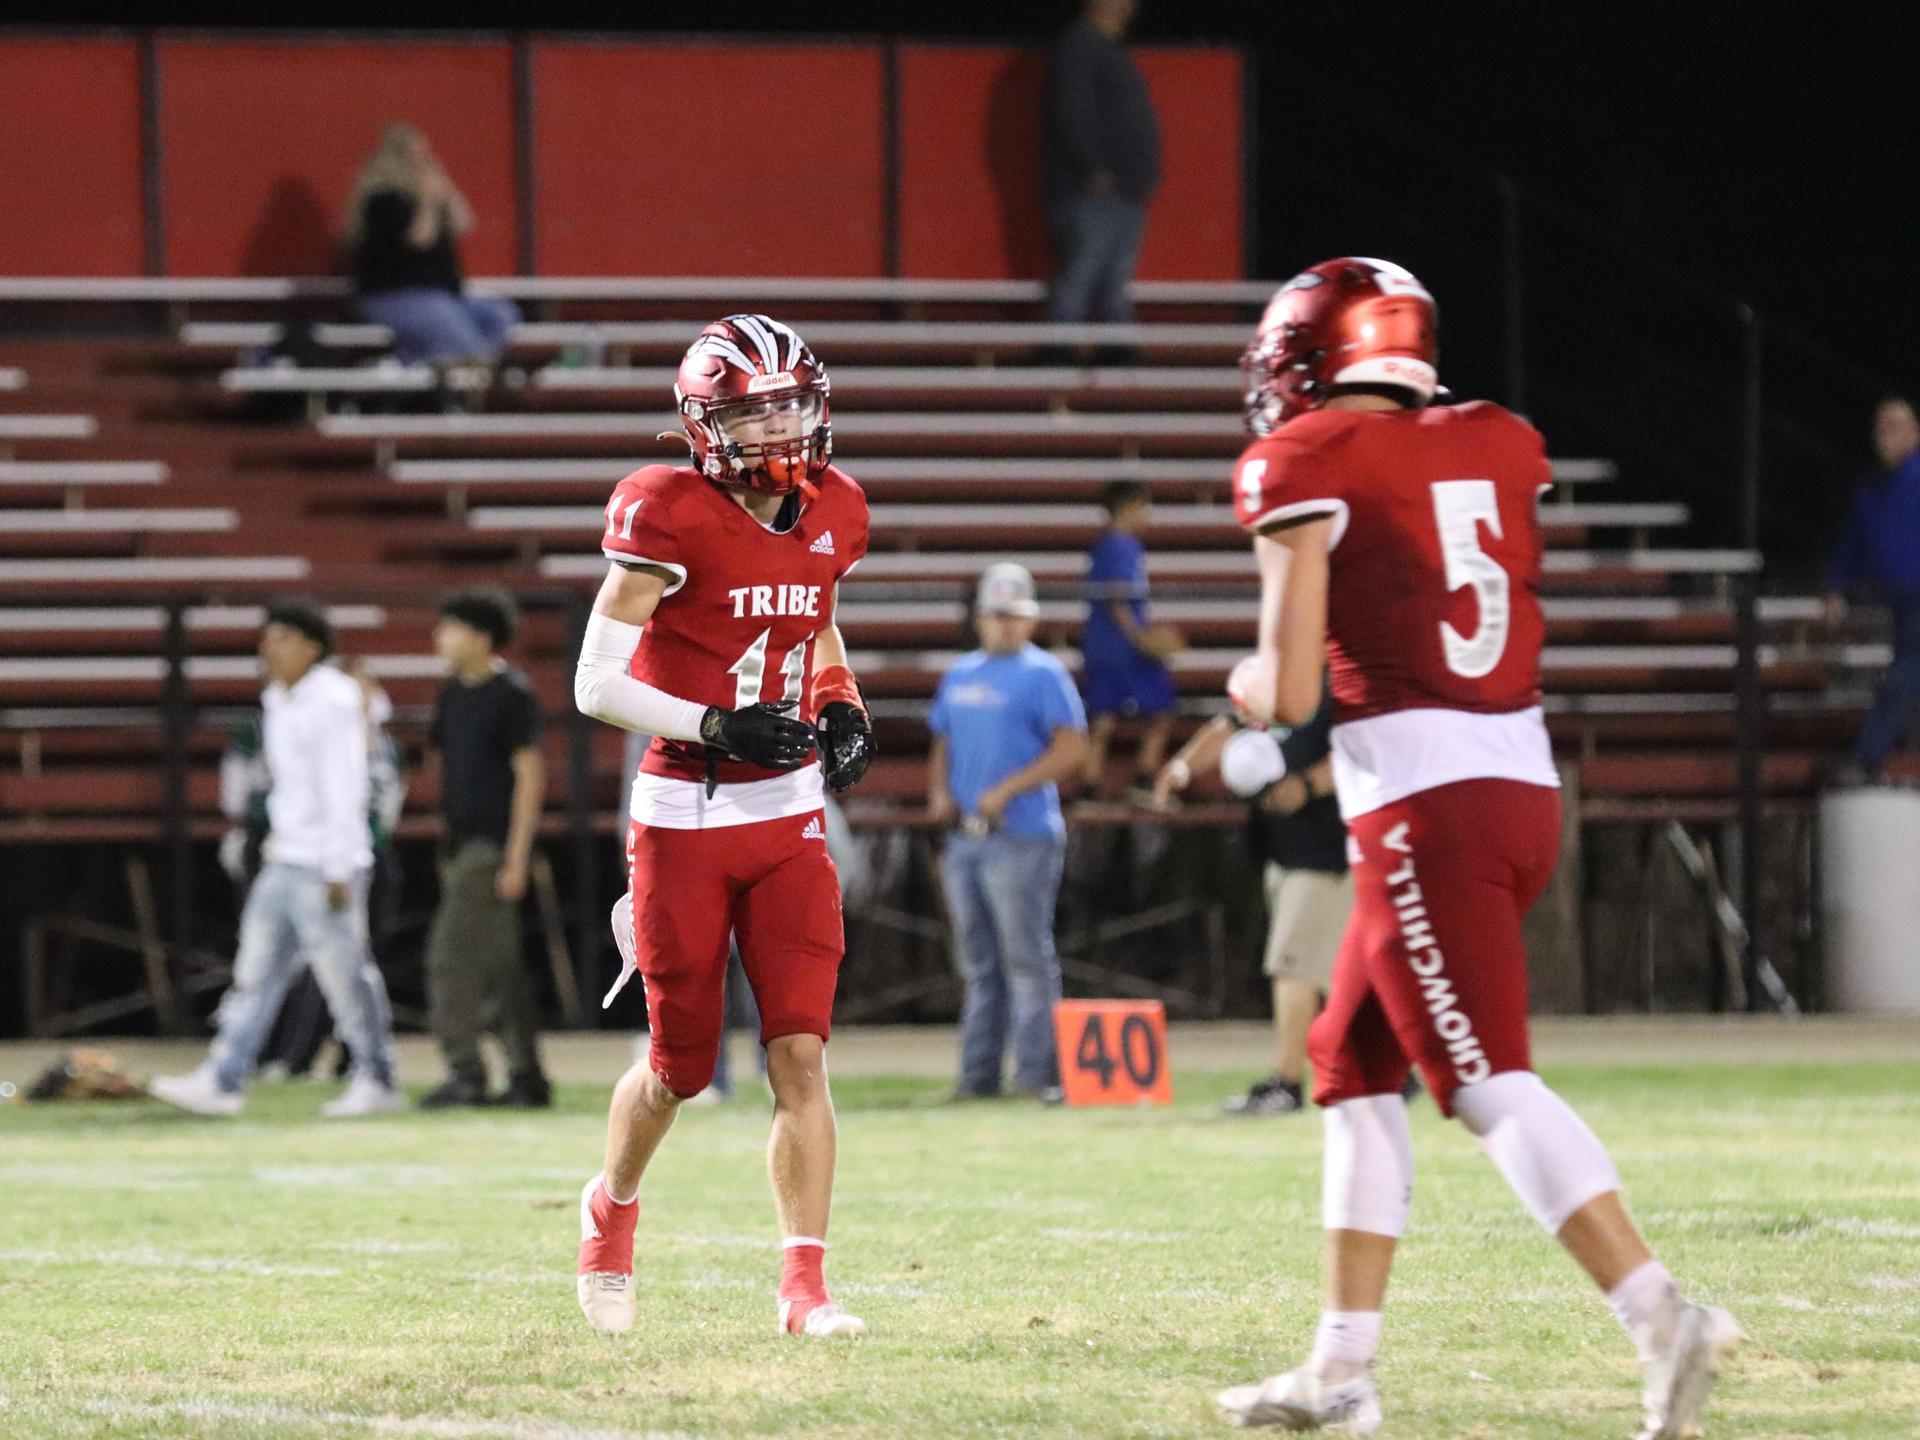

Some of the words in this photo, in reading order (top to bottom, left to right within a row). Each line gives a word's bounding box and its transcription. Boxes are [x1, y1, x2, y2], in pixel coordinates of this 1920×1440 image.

[605, 494, 645, 541] 11
[1241, 459, 1268, 513] 5
[728, 584, 822, 619] TRIBE
[1430, 479, 1510, 679] 5
[726, 626, 816, 721] 11
[1382, 821, 1492, 1086] CHOWCHILLA
[1076, 1013, 1157, 1088] 40
